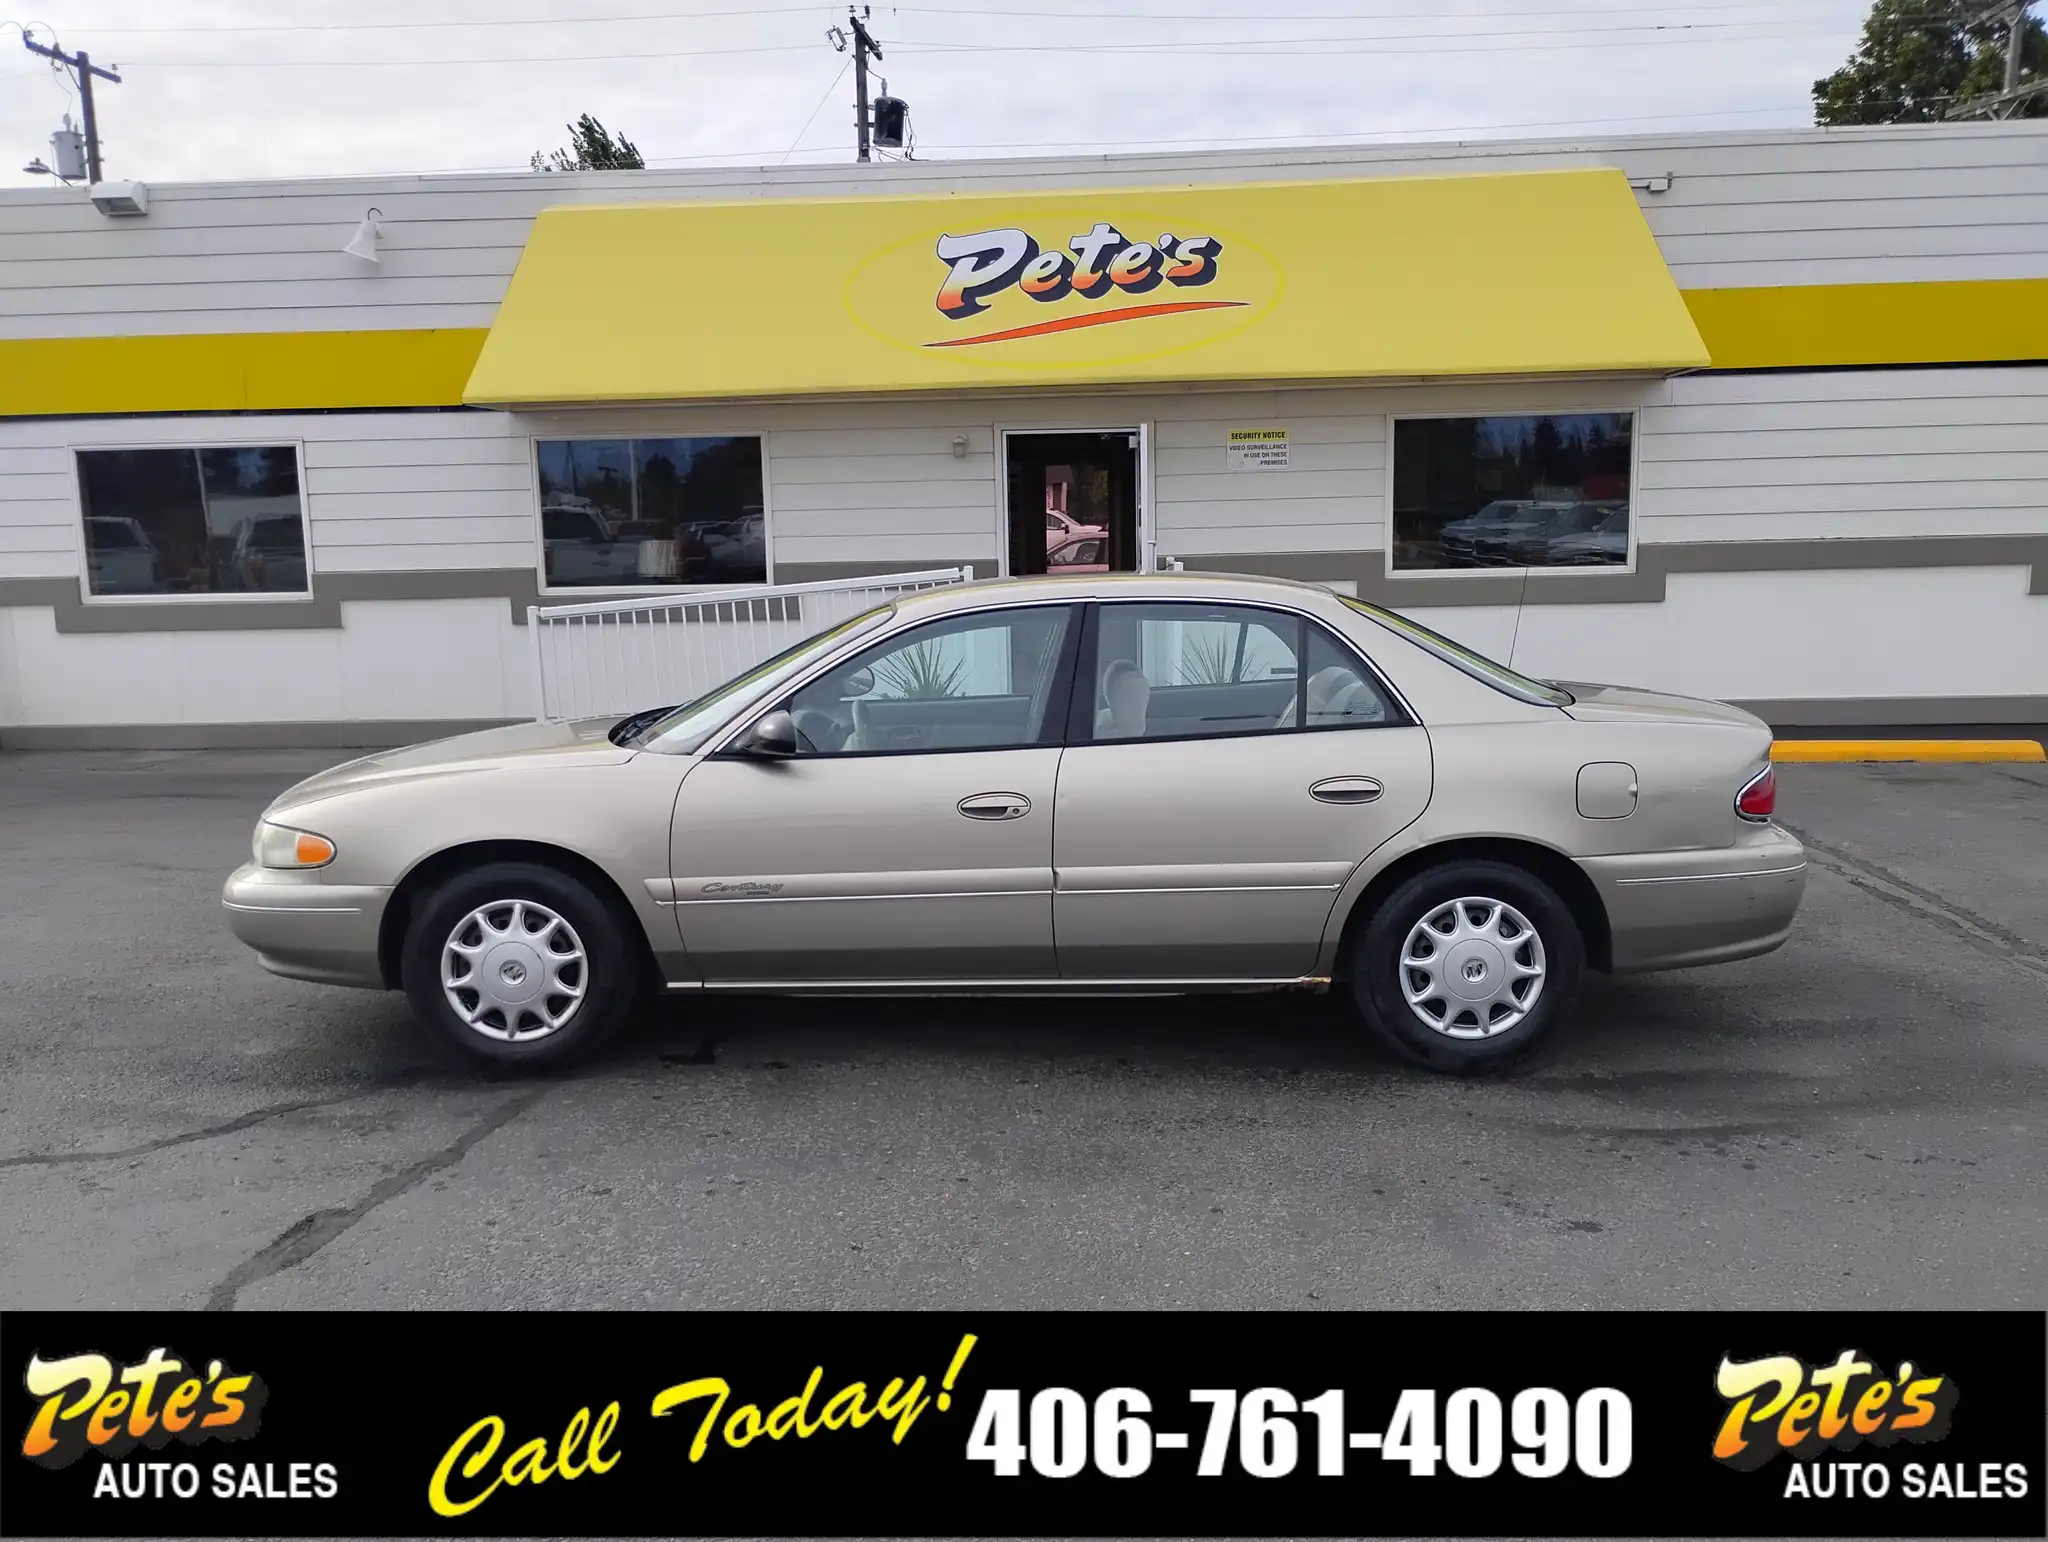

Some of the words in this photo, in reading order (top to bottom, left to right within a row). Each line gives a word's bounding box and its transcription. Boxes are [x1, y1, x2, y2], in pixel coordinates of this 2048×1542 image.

[935, 223, 1221, 319] Pete's
[1231, 432, 1261, 440] SECURITY
[1263, 431, 1286, 439] NOTICE
[700, 881, 784, 894] Century
